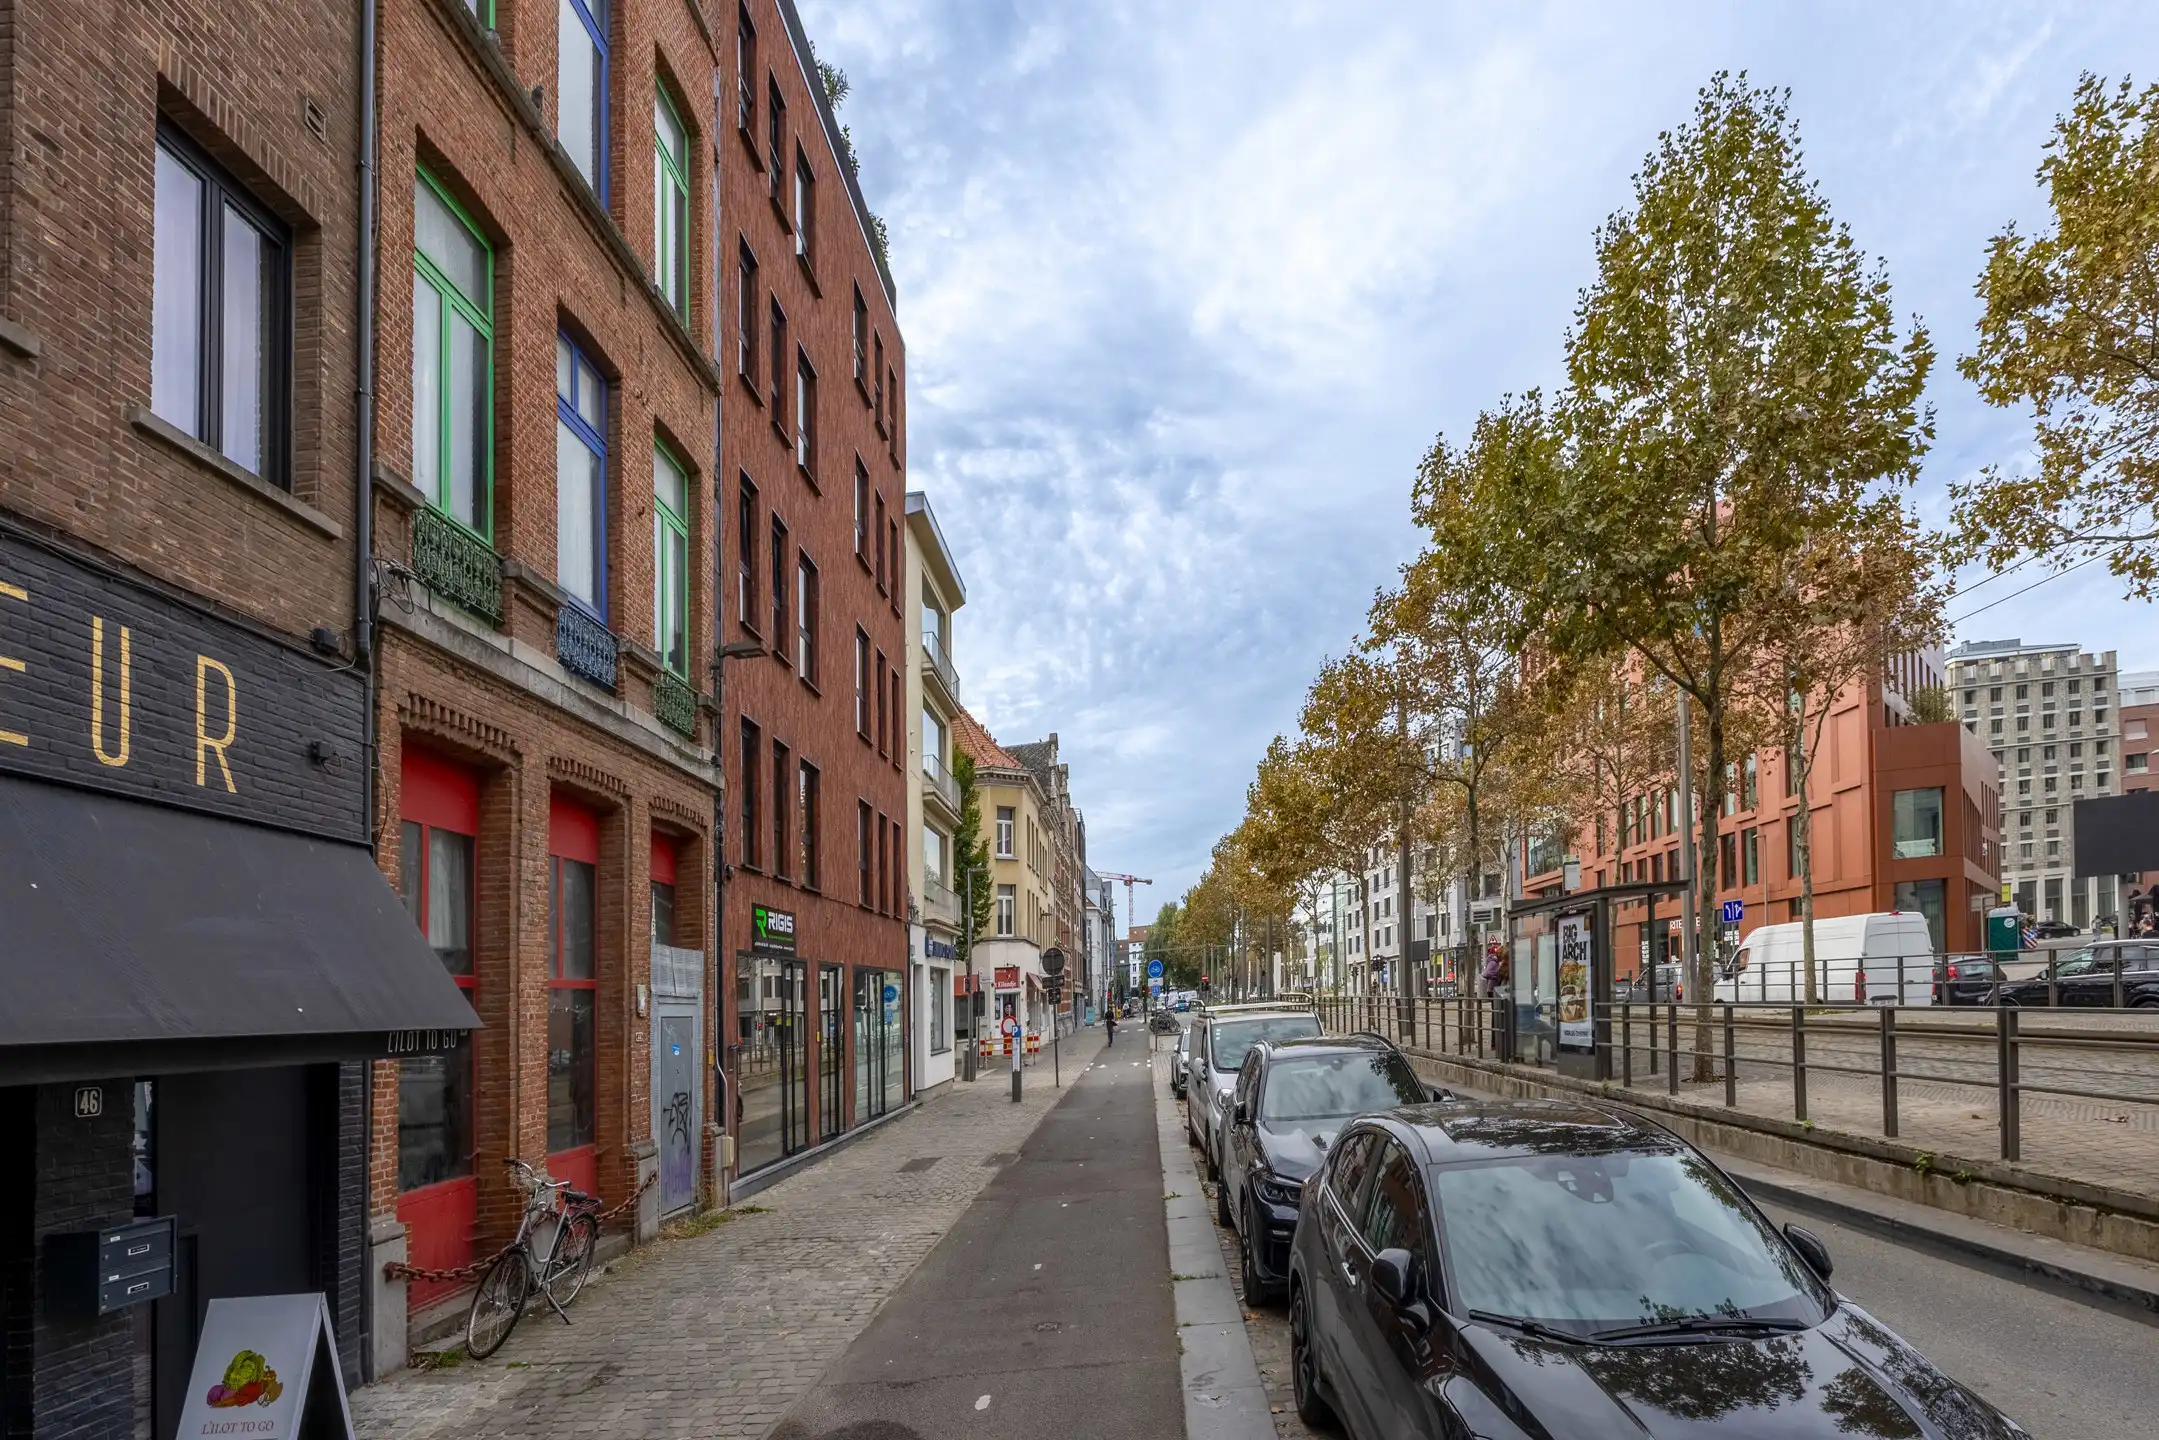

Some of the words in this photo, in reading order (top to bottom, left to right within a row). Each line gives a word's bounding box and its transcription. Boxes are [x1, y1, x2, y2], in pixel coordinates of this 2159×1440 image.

[768, 911, 794, 934] RIGIS
[1563, 923, 1578, 943] BIG
[1562, 941, 1587, 961] ARCH
[425, 1029, 438, 1050] TO
[443, 1028, 457, 1049] GO
[80, 1090, 99, 1114] 46
[240, 1421, 256, 1433] TO
[258, 1420, 274, 1432] GO
